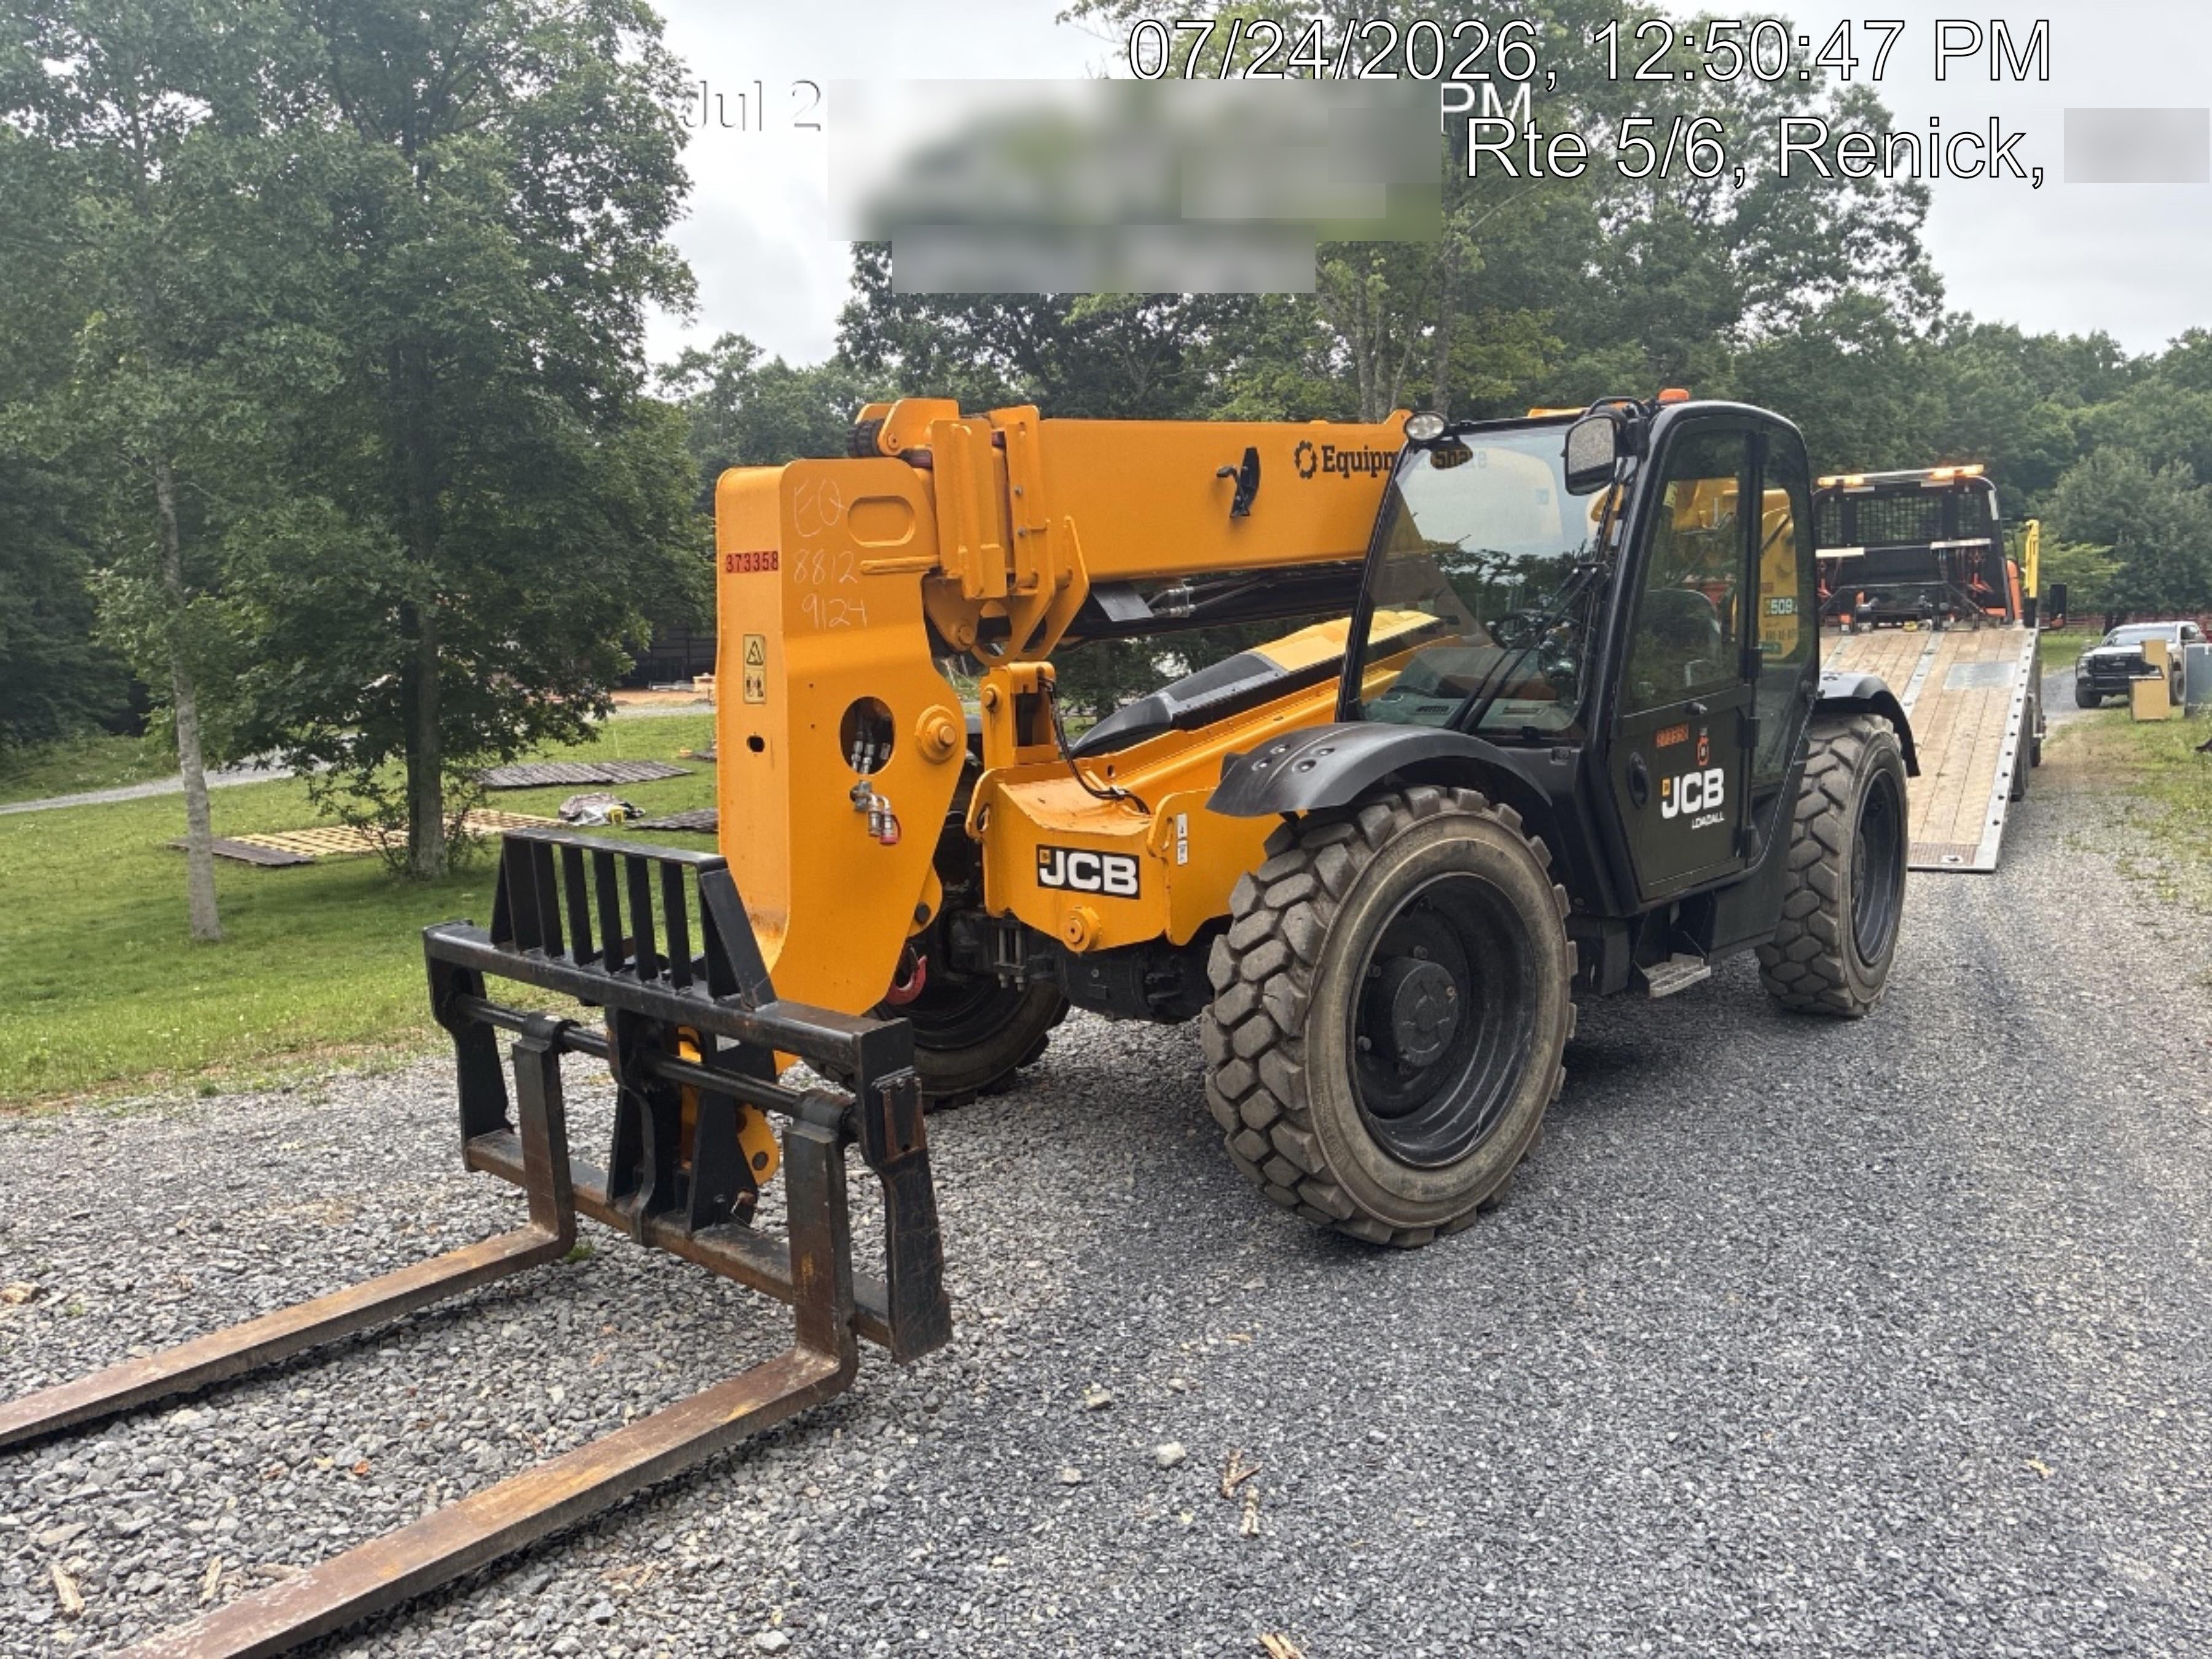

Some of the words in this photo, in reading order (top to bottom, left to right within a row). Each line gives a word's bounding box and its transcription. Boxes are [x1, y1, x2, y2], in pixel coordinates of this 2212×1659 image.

[726, 551, 779, 573] 373358
[794, 549, 858, 586] 8812
[801, 592, 868, 630] 9124
[1661, 768, 1725, 819] JCB
[1039, 850, 1138, 895] JCB
